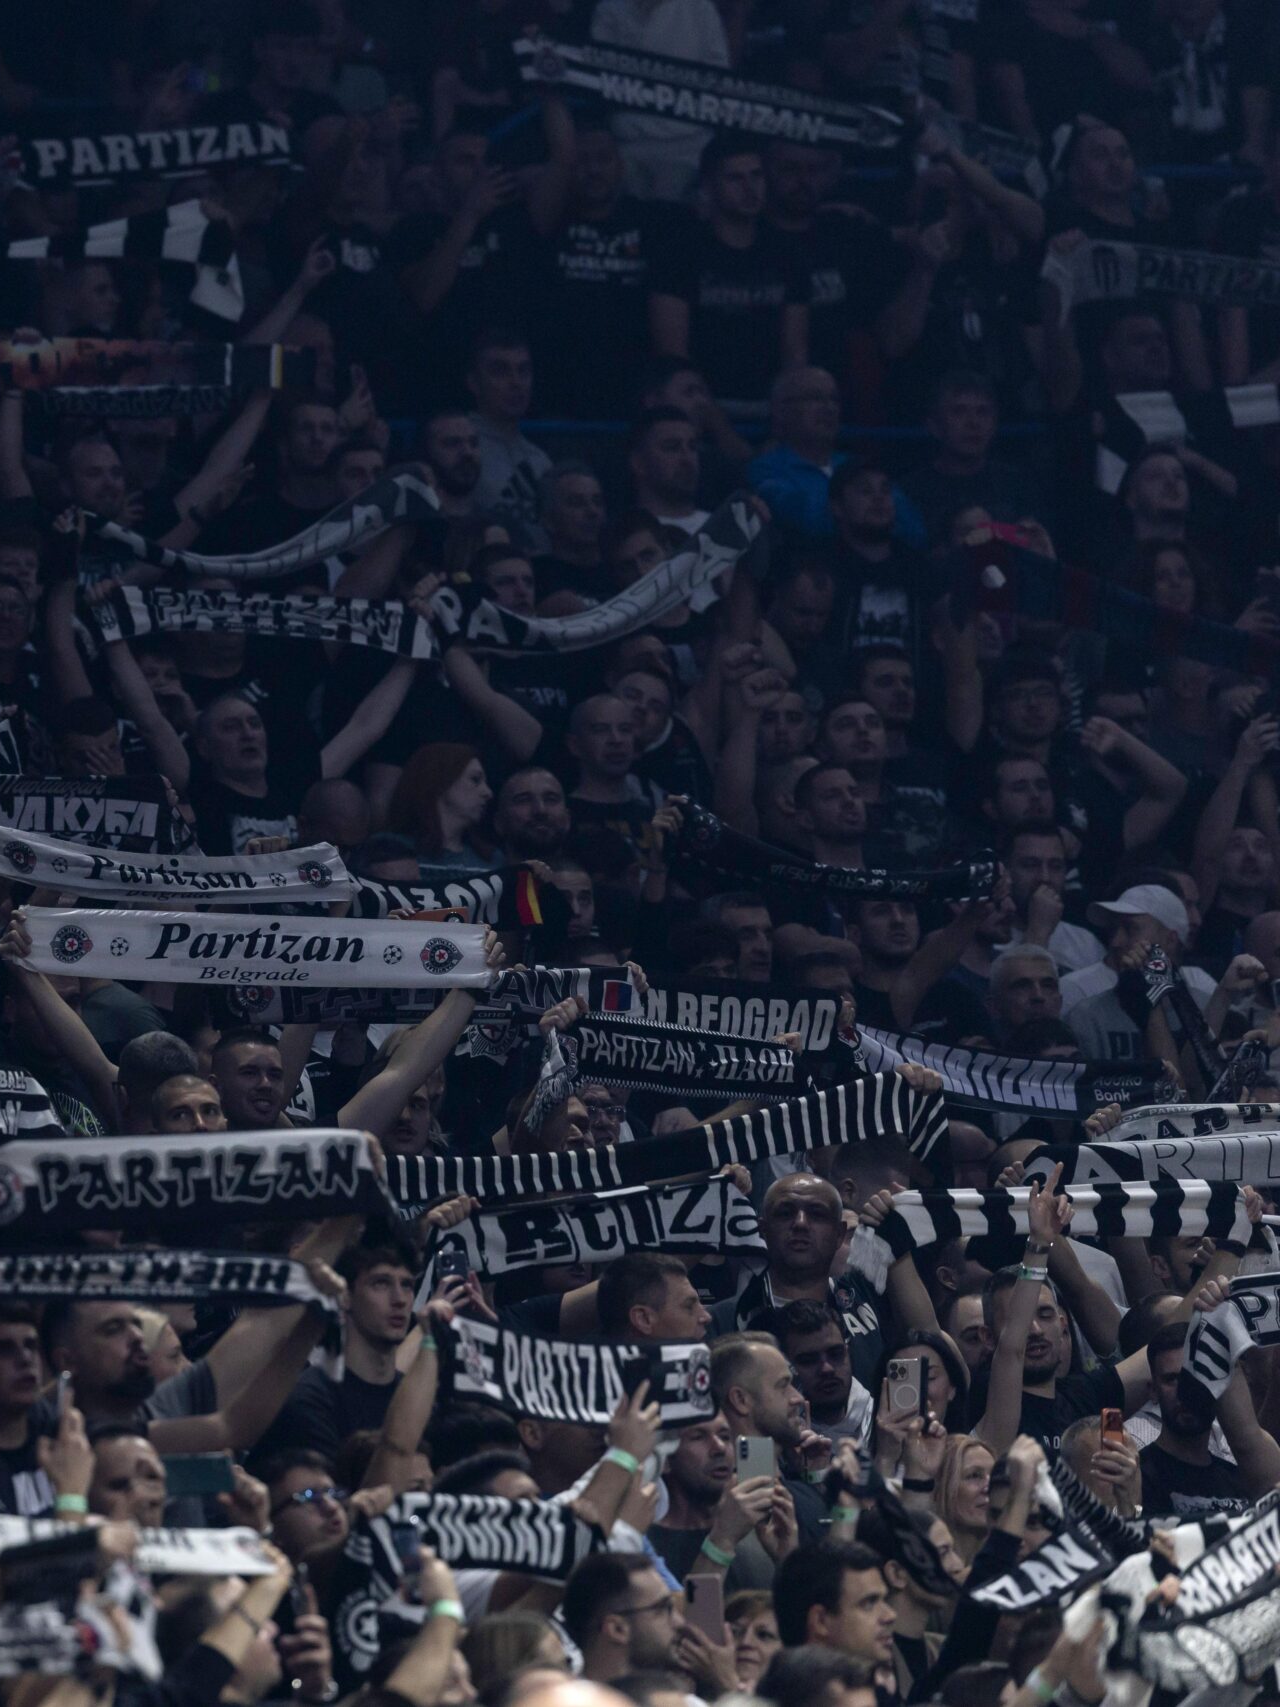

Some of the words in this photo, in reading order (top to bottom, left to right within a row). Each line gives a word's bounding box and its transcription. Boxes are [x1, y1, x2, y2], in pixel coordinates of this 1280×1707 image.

[31, 121, 290, 178] PARTIZAN
[85, 854, 257, 890] Partizan
[147, 922, 366, 963] Partizan
[200, 966, 311, 984] Belgrade
[676, 991, 838, 1051] BEOGRAD
[578, 1026, 696, 1076] PARTIZAN
[1094, 1088, 1131, 1103] Bank
[34, 1138, 359, 1214] PARTIZAN
[502, 1328, 641, 1425] PARTIZA
